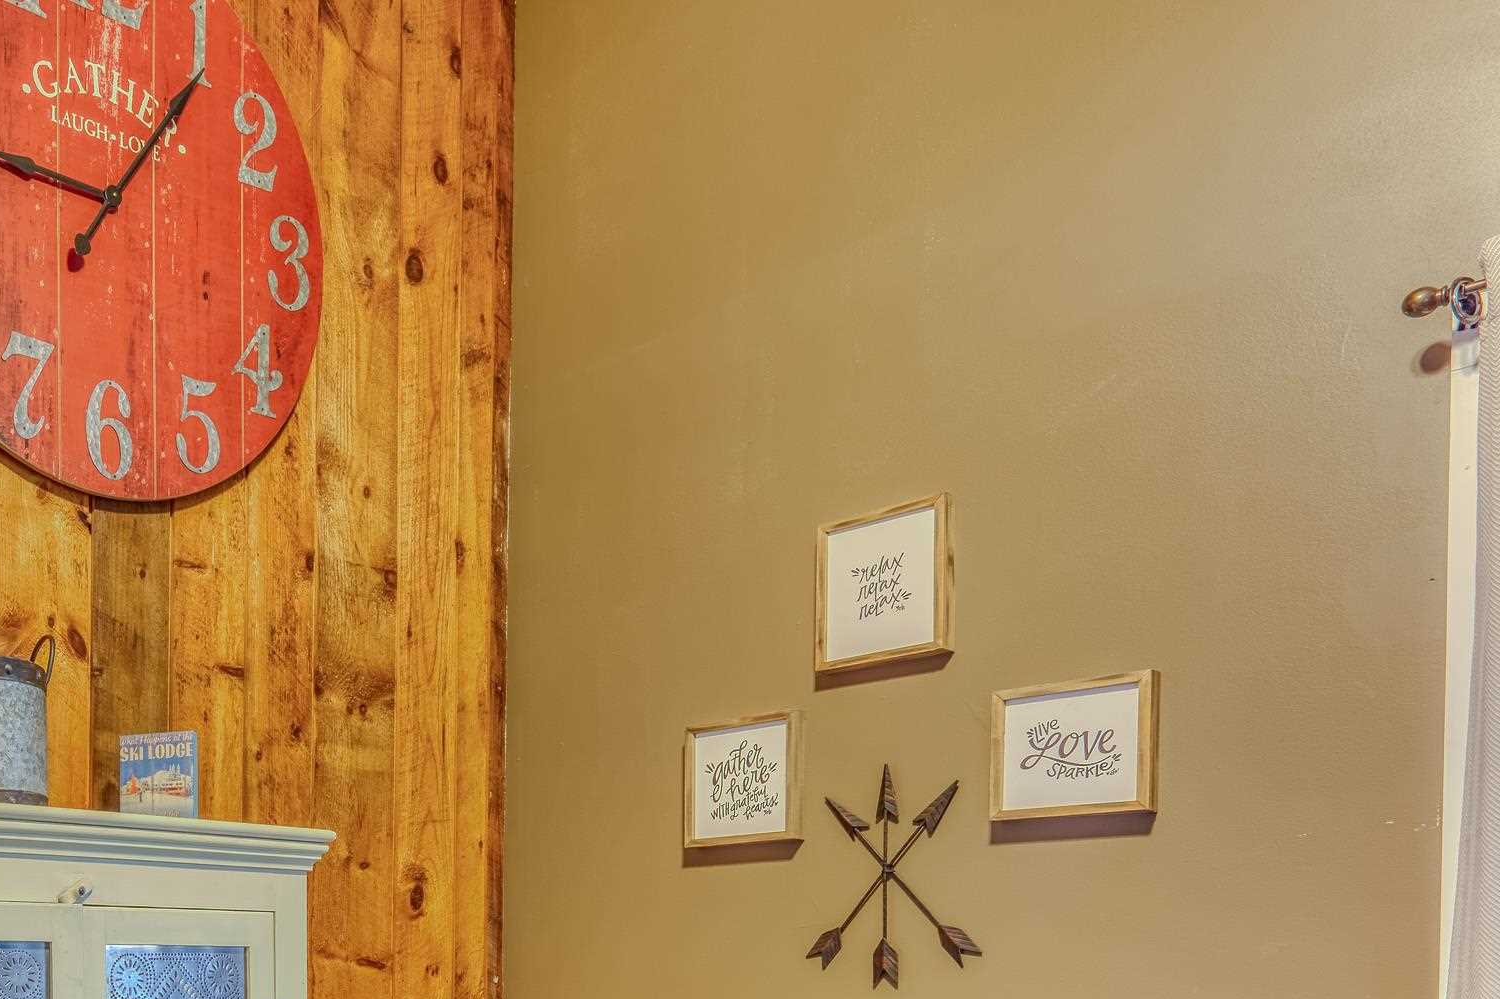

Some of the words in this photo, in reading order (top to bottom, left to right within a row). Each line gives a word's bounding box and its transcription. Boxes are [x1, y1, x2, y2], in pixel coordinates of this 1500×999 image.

[187, 0, 212, 88] 1
[51, 105, 109, 142] LAUGH
[233, 92, 277, 192] 2
[267, 215, 310, 312] 3
[1, 331, 55, 440] 7
[232, 324, 283, 418] 4
[86, 379, 133, 480] 6
[176, 375, 220, 474] 5
[857, 574, 901, 602] relax
[859, 552, 904, 583] relax
[859, 588, 902, 620] relax
[120, 745, 143, 762] SKI
[148, 742, 193, 760] LODGE
[726, 765, 770, 802] here
